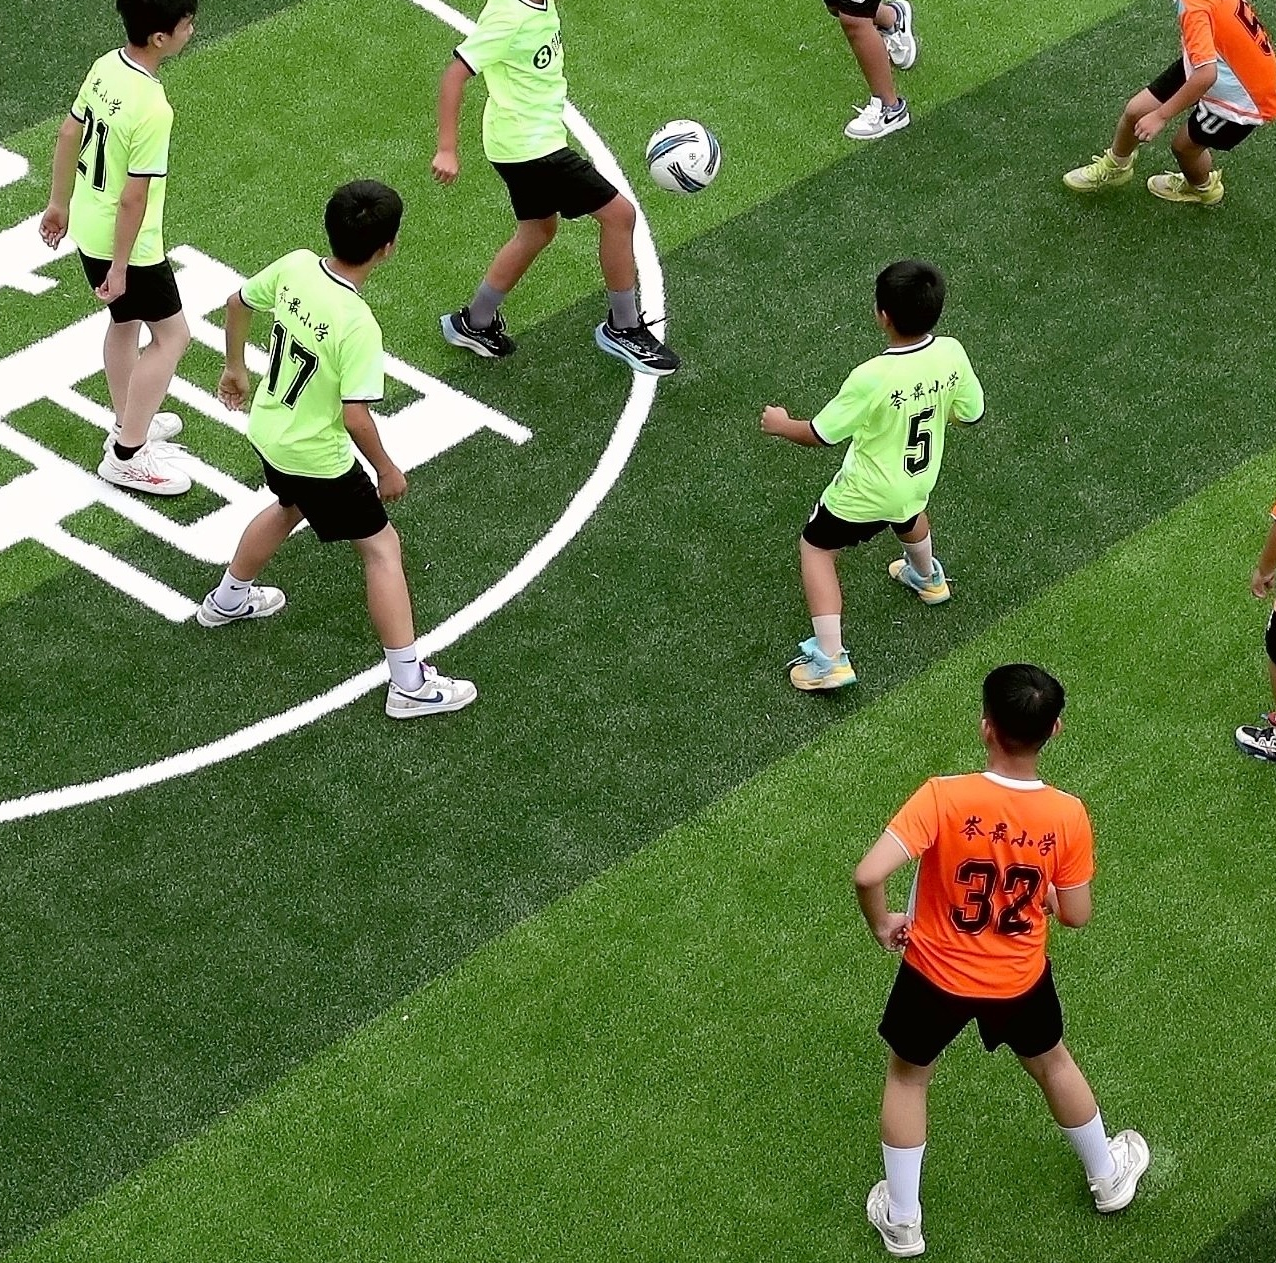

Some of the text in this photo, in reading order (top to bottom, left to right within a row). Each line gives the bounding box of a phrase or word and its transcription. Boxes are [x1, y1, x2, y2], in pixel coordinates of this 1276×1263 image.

[77, 104, 109, 193] 21
[267, 320, 320, 410] 17
[889, 371, 960, 410] 岑最小学
[903, 404, 937, 478] 5
[959, 815, 1057, 857] 岑最小学
[949, 857, 1043, 936] 32
